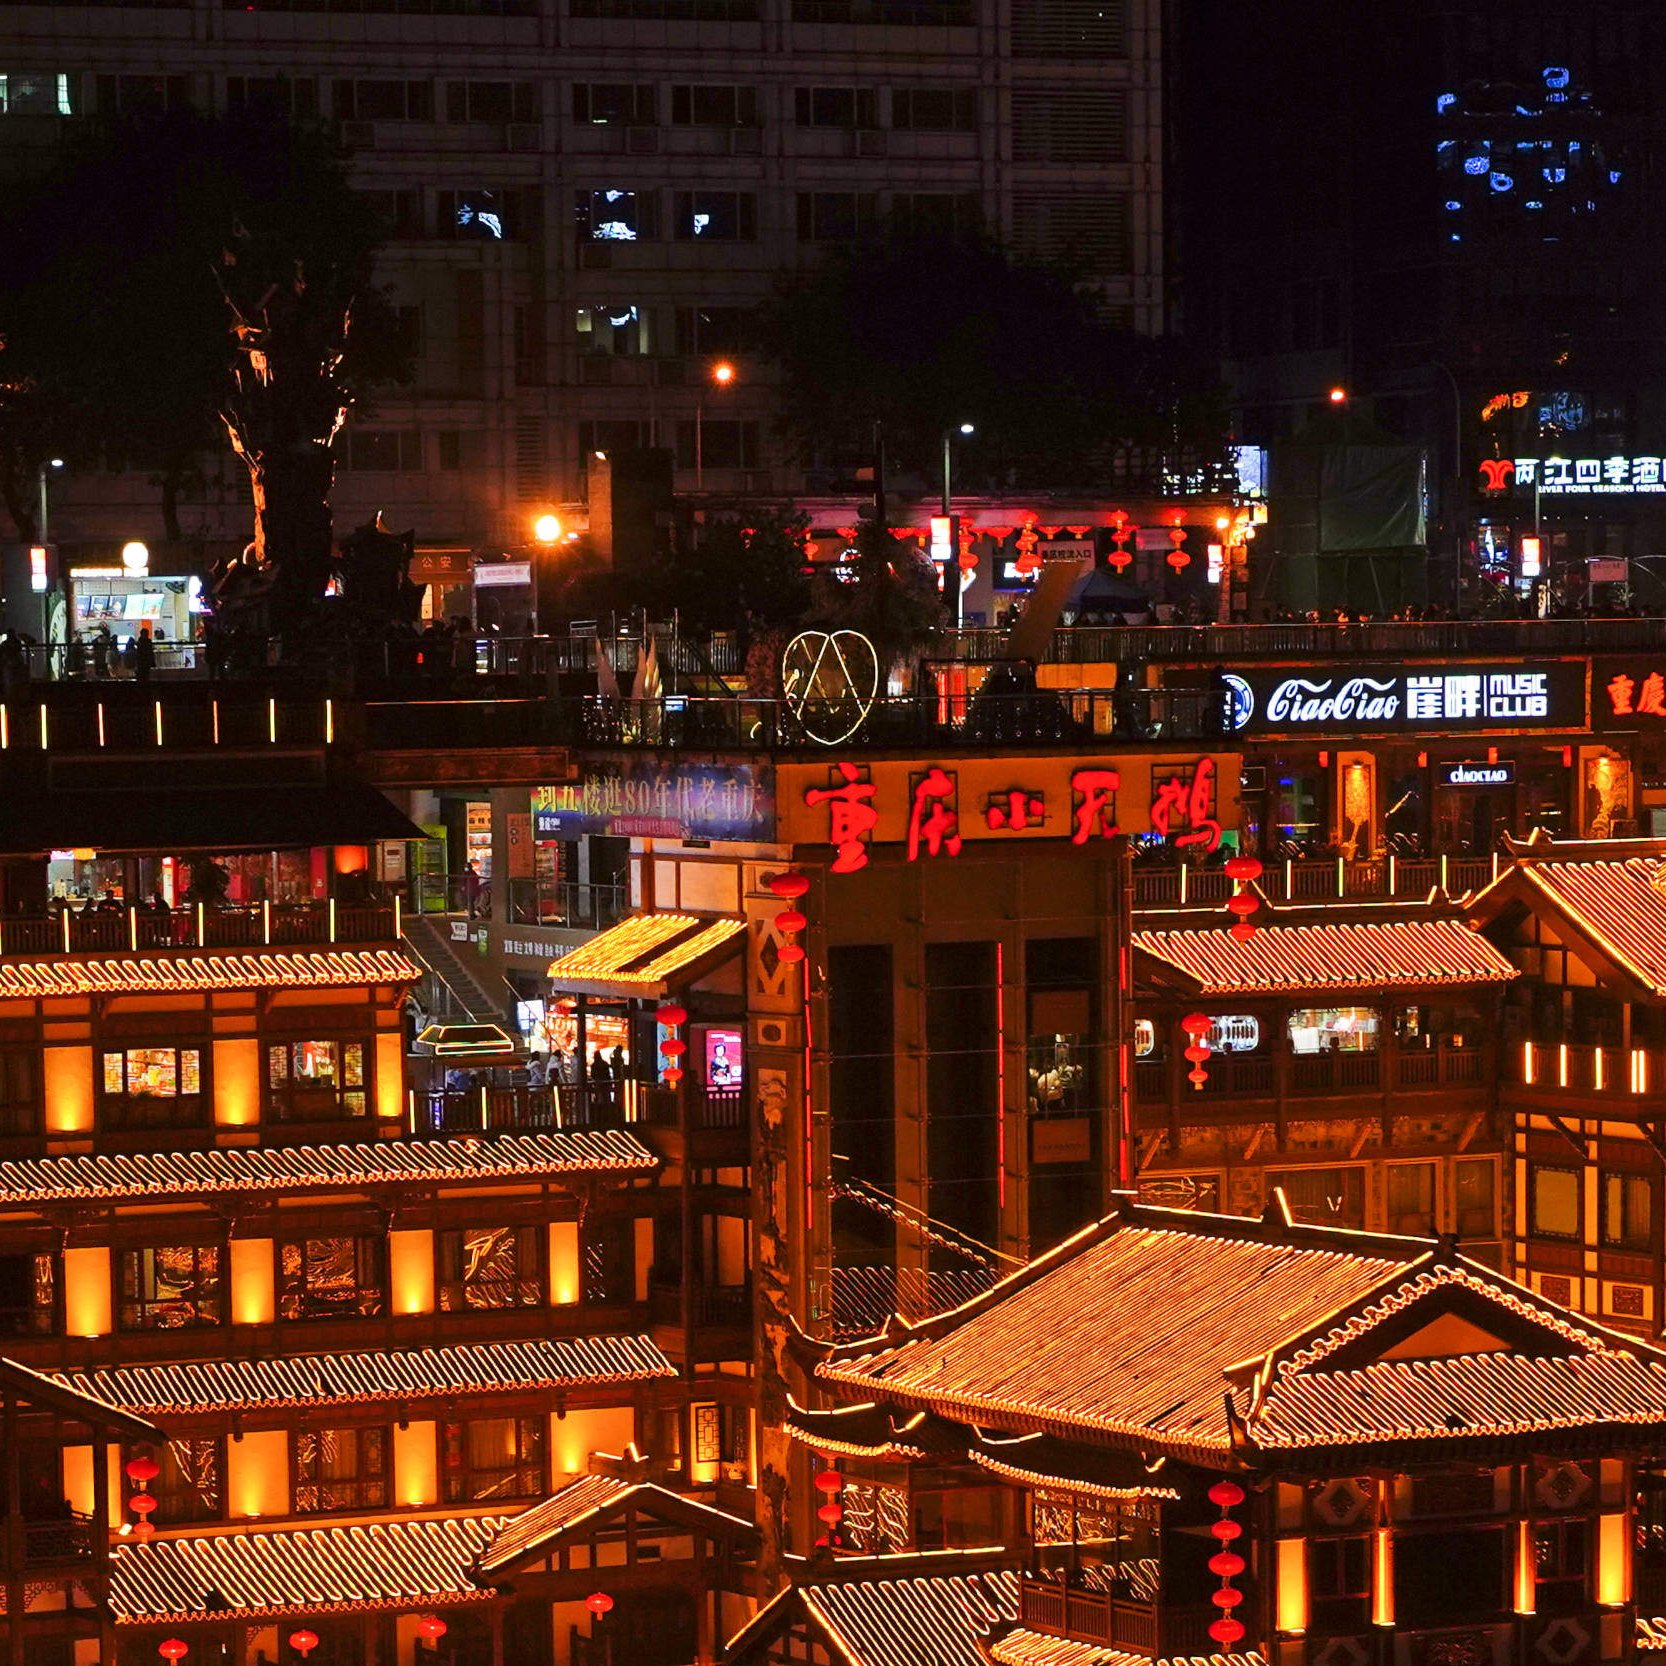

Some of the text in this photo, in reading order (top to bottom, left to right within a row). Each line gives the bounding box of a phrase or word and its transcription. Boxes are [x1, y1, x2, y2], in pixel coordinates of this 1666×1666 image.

[422, 556, 452, 569] 公安
[1489, 673, 1548, 696] MUSIC
[1489, 695, 1548, 718] CLUB
